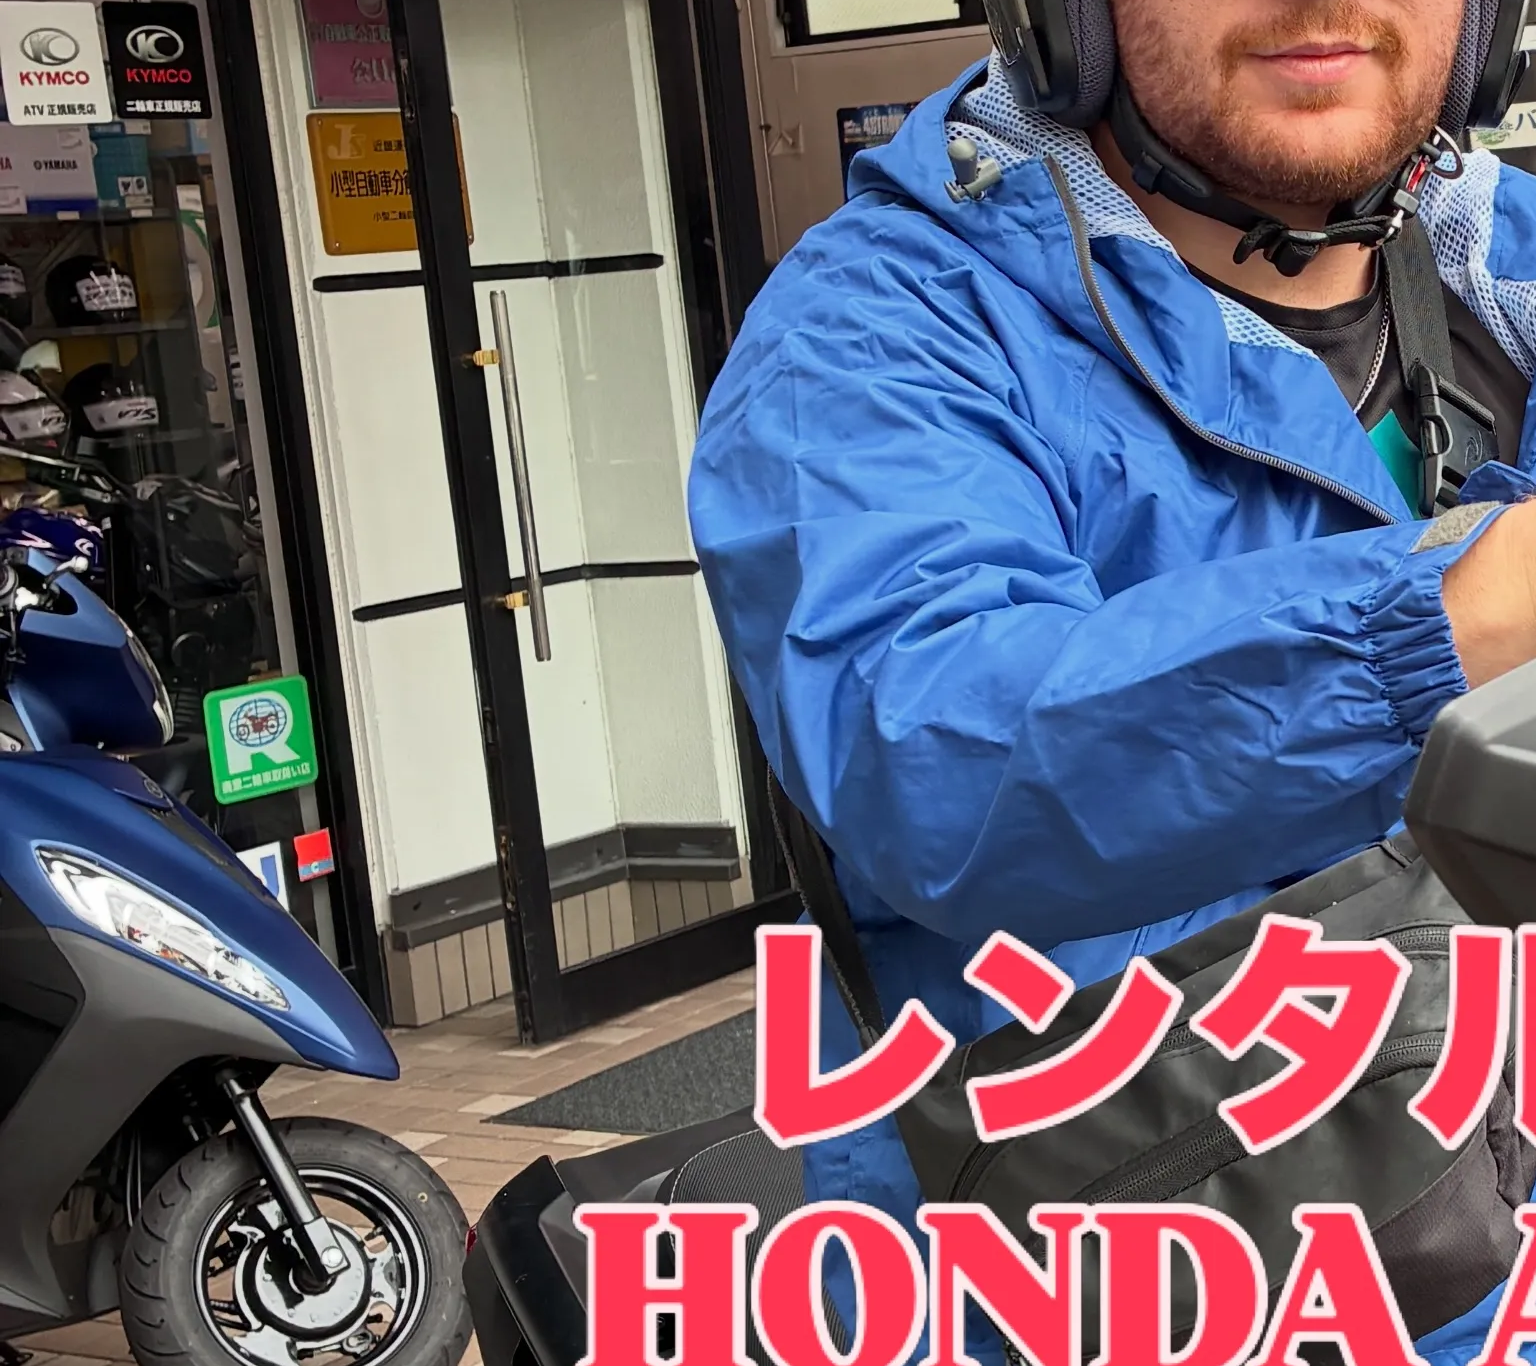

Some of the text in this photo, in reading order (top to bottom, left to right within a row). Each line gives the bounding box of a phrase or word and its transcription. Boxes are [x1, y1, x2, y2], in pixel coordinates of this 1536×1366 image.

[20, 70, 90, 86] KYMCO
[126, 67, 192, 83] KYMCO
[24, 104, 44, 117] ATV
[44, 159, 78, 170] YAMAHA
